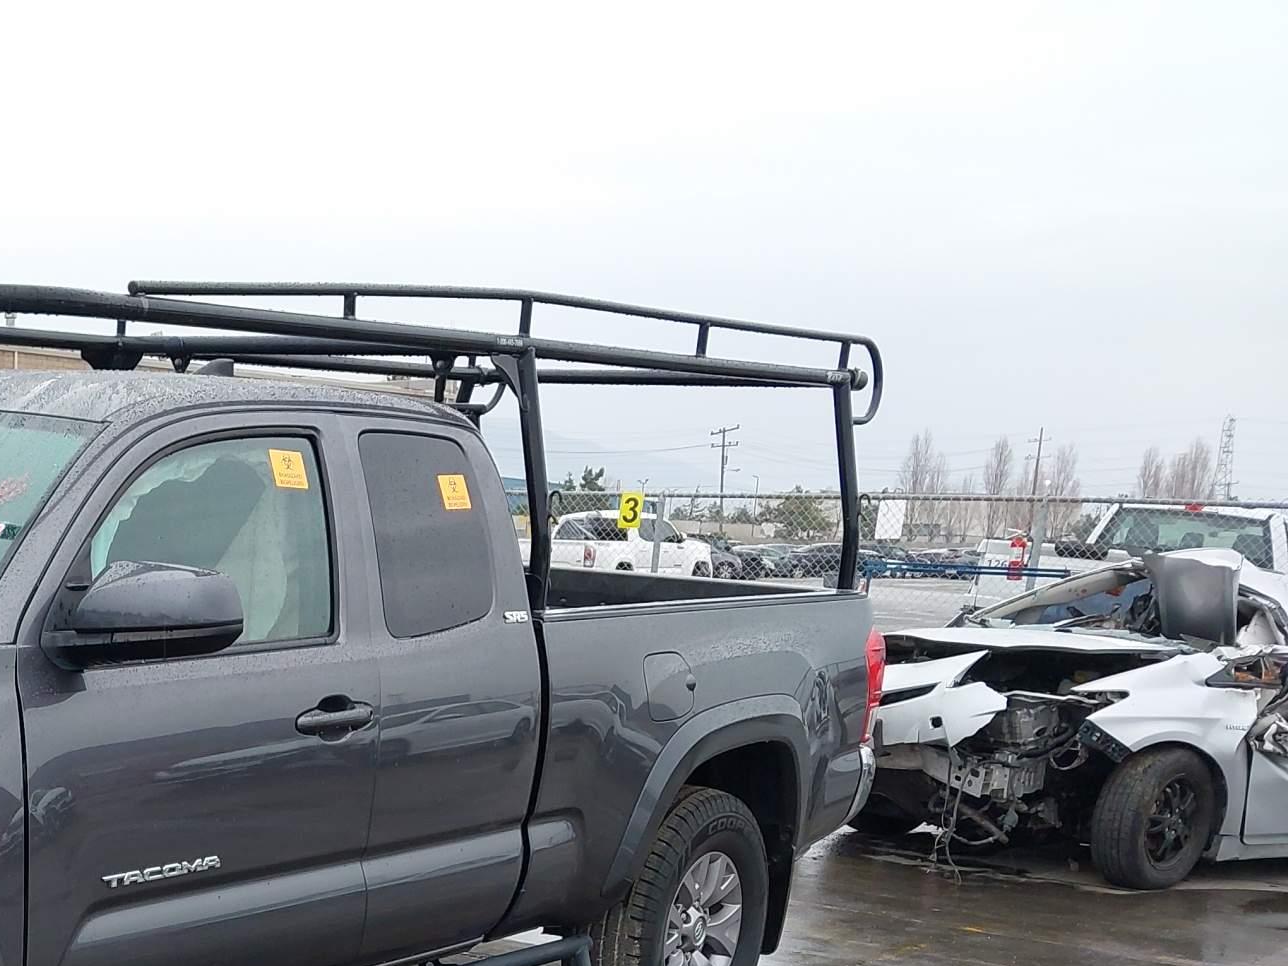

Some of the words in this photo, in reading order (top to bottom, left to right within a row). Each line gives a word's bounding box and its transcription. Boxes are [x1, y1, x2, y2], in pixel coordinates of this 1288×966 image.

[622, 497, 639, 524] 3
[503, 610, 529, 623] SR5
[101, 855, 221, 888] TACOMA
